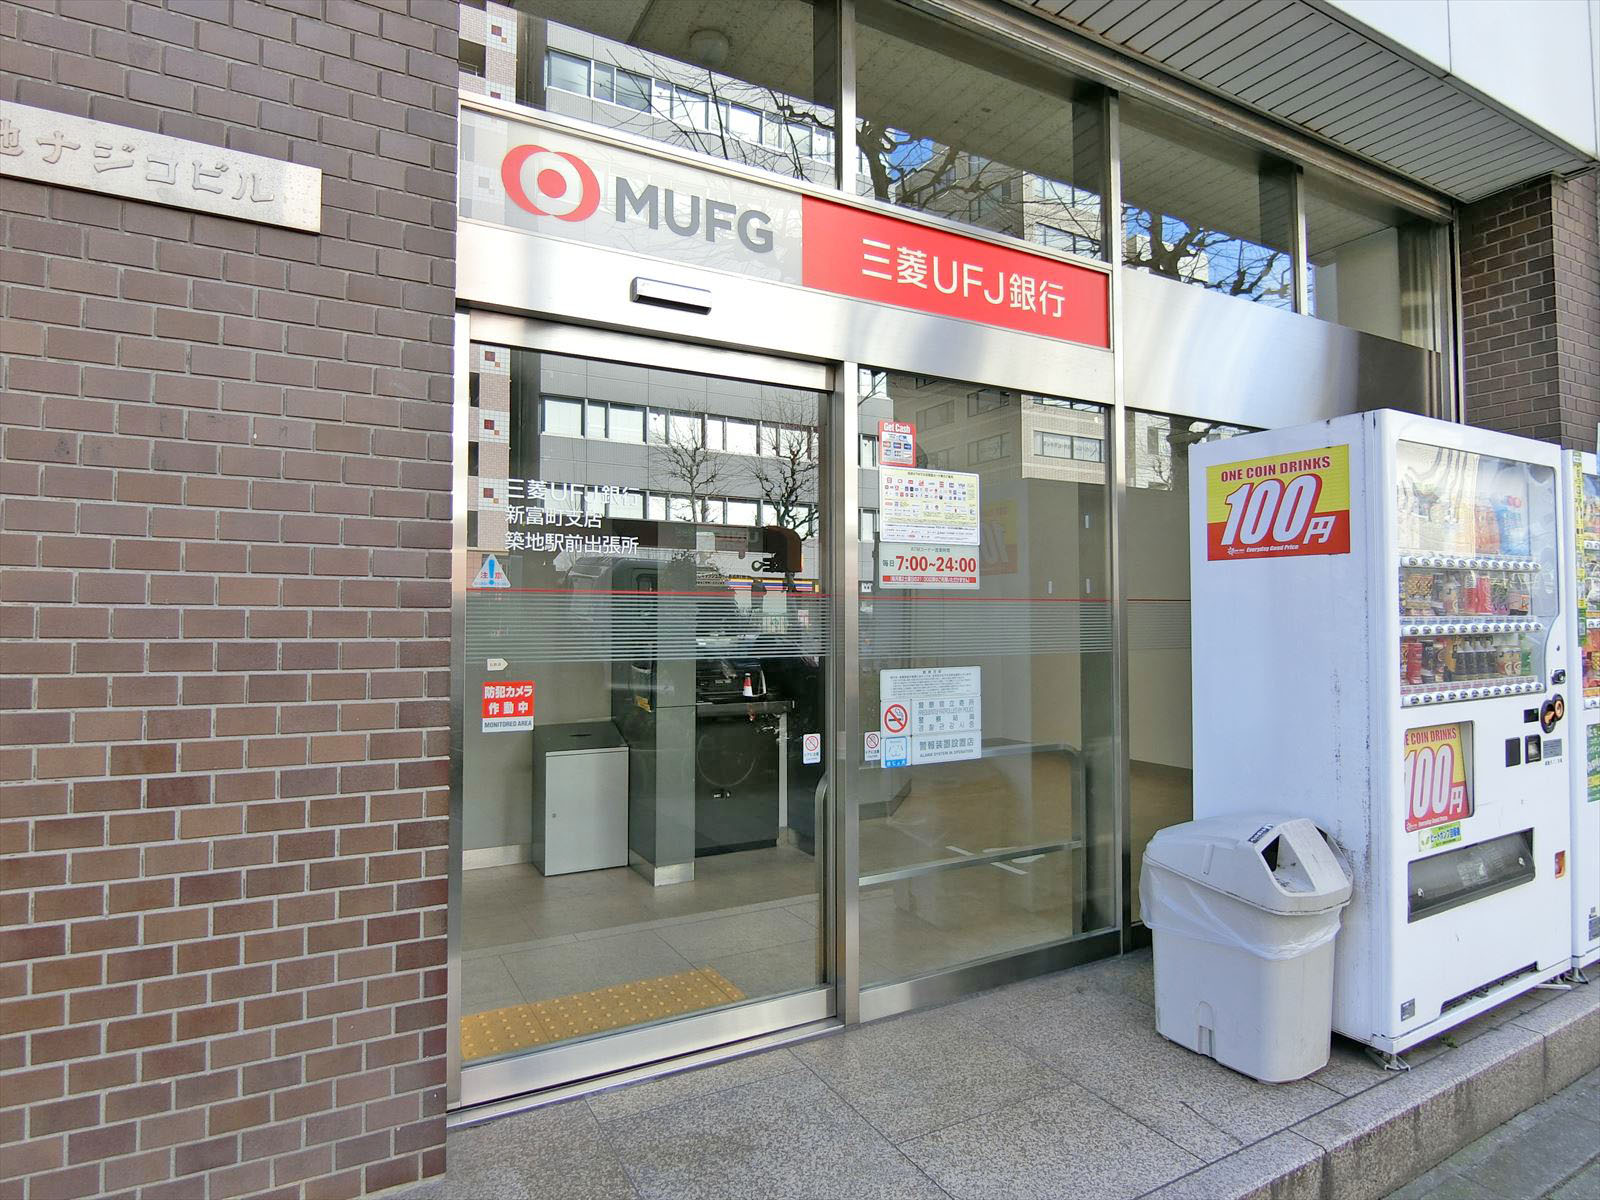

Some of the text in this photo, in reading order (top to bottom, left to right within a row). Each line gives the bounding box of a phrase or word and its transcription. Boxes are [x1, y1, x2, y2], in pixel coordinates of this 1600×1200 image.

[616, 176, 774, 254] MUFG
[861, 238, 1066, 318] 三菱UFJ銀行
[883, 421, 911, 434] Get Cash
[1221, 456, 1331, 482] ONE COIN DRINKS
[506, 478, 641, 504] 三菱UFJ銀行
[505, 504, 603, 529] 新富町支店
[1220, 474, 1337, 546] 100円
[504, 530, 640, 556] 築地駅前出張所
[484, 685, 533, 699] 防犯カメラ
[484, 719, 533, 729] MONITORED AREA
[1411, 731, 1429, 745] COIN
[1430, 727, 1457, 743] DRINKS
